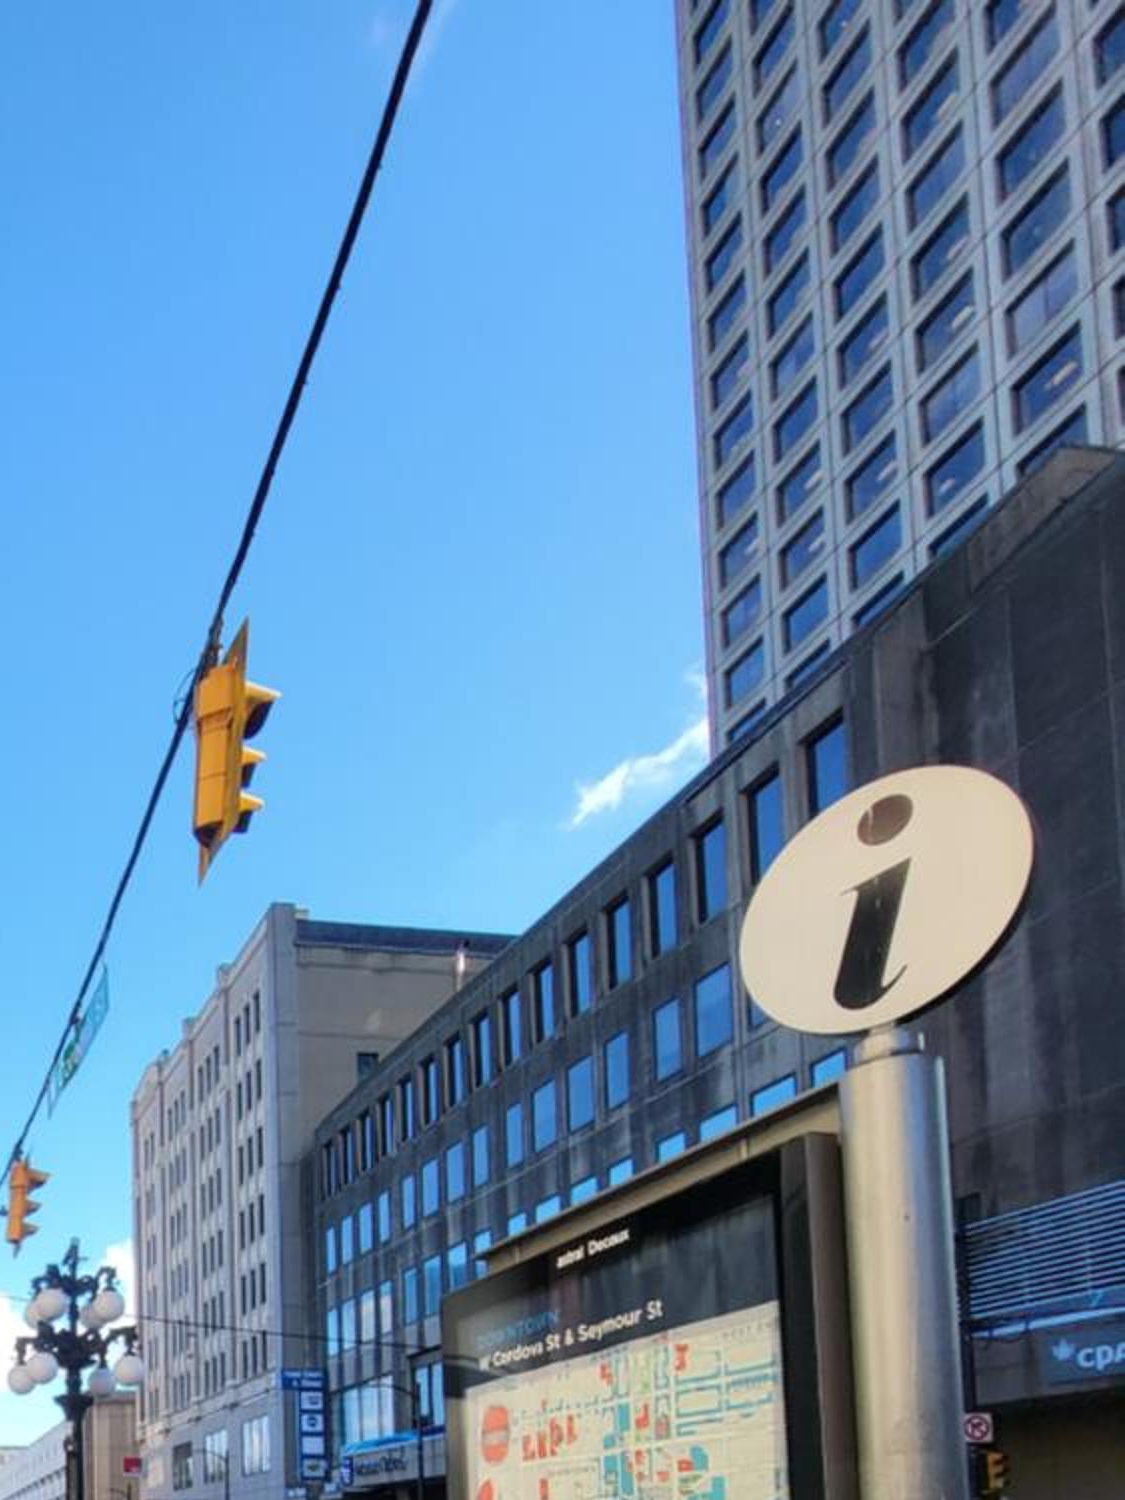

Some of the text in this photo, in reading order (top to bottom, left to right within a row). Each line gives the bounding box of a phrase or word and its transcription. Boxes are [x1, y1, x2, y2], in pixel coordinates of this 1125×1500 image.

[833, 794, 914, 1011] i
[492, 1343, 544, 1367] Cordova
[545, 1333, 561, 1352] St
[565, 1327, 575, 1347] &
[577, 1308, 643, 1342] Seymour
[646, 1299, 664, 1321] St
